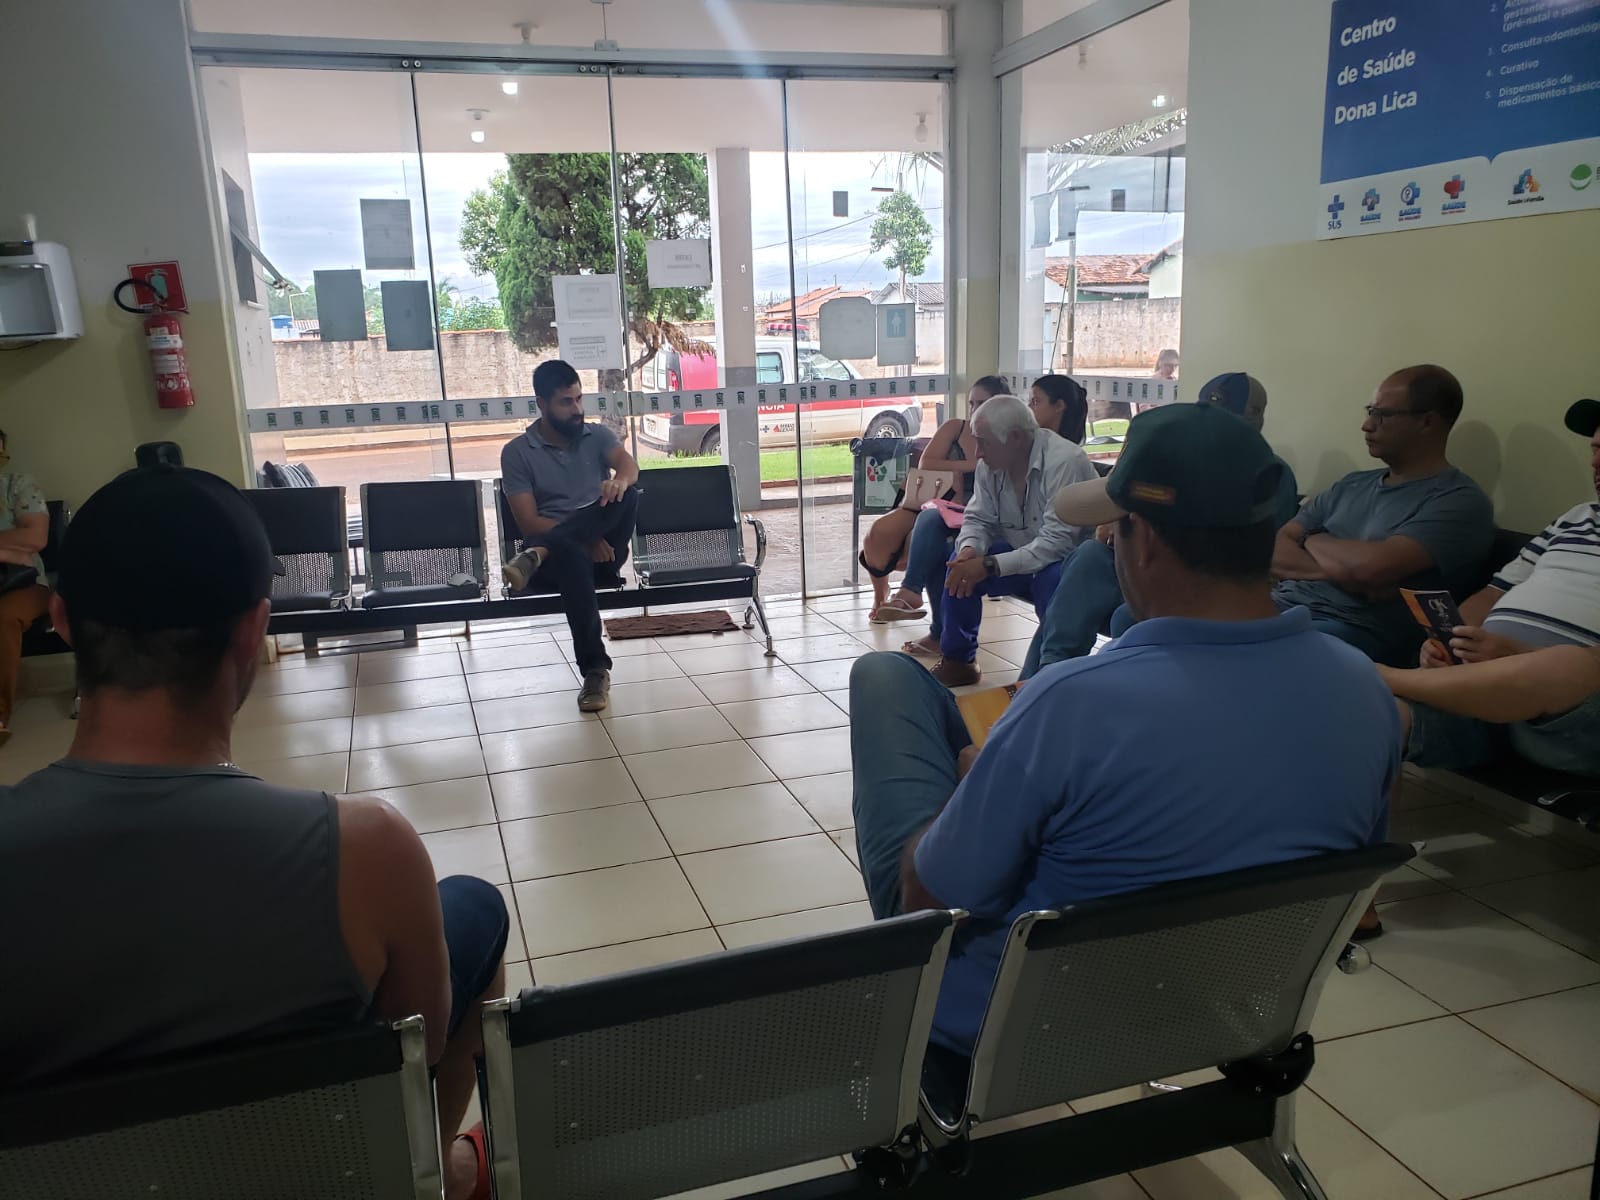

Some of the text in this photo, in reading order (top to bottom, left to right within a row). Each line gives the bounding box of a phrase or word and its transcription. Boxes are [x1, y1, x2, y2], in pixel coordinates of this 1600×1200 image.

[1340, 15, 1397, 47] Centro
[1501, 36, 1543, 54] Consulta
[1337, 48, 1417, 87] de Saúde
[1499, 59, 1540, 76] Curativo
[1498, 77, 1559, 98] Dispensação
[1560, 73, 1574, 84] de
[1498, 86, 1567, 109] medicamentos
[1334, 90, 1418, 126] Dona Lica
[1327, 220, 1342, 231] SUS
